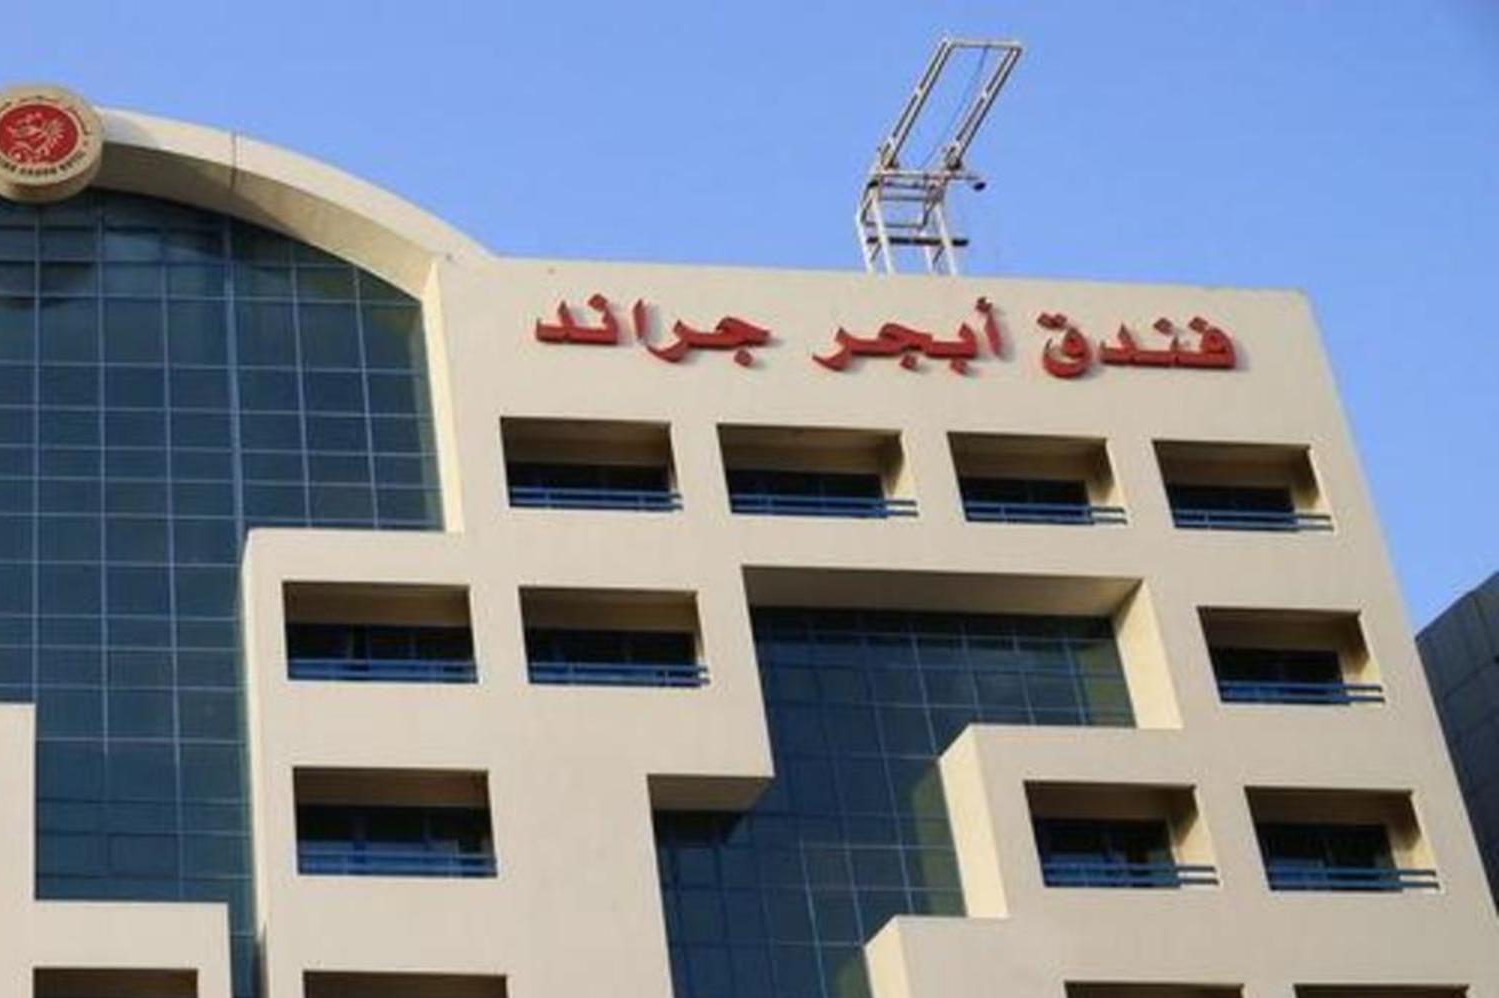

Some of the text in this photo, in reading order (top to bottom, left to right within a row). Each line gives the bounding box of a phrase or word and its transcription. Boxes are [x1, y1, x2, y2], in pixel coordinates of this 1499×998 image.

[534, 293, 1238, 379] فندق أبجر جراند
